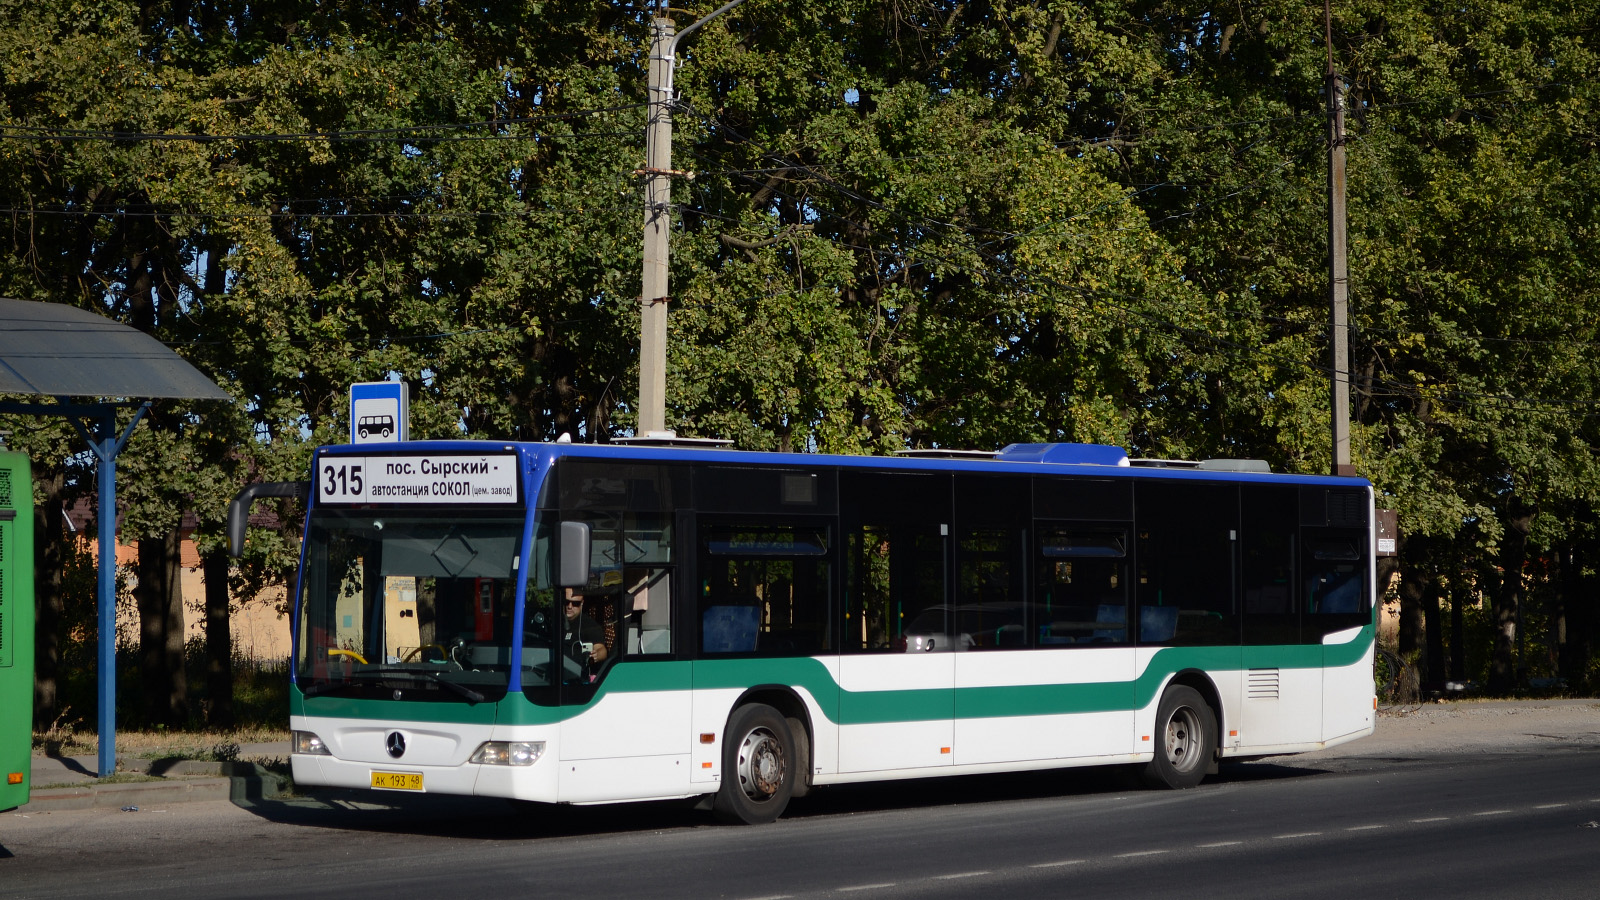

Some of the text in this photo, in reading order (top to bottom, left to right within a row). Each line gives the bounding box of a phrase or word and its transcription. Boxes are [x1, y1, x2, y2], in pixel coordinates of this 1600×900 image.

[386, 463, 416, 475] пос.
[421, 458, 489, 479] Сырский
[324, 465, 363, 496] 315
[372, 481, 513, 498] автостанция СОКОЛ (цем. завод)
[375, 774, 420, 787] АК 193 48
